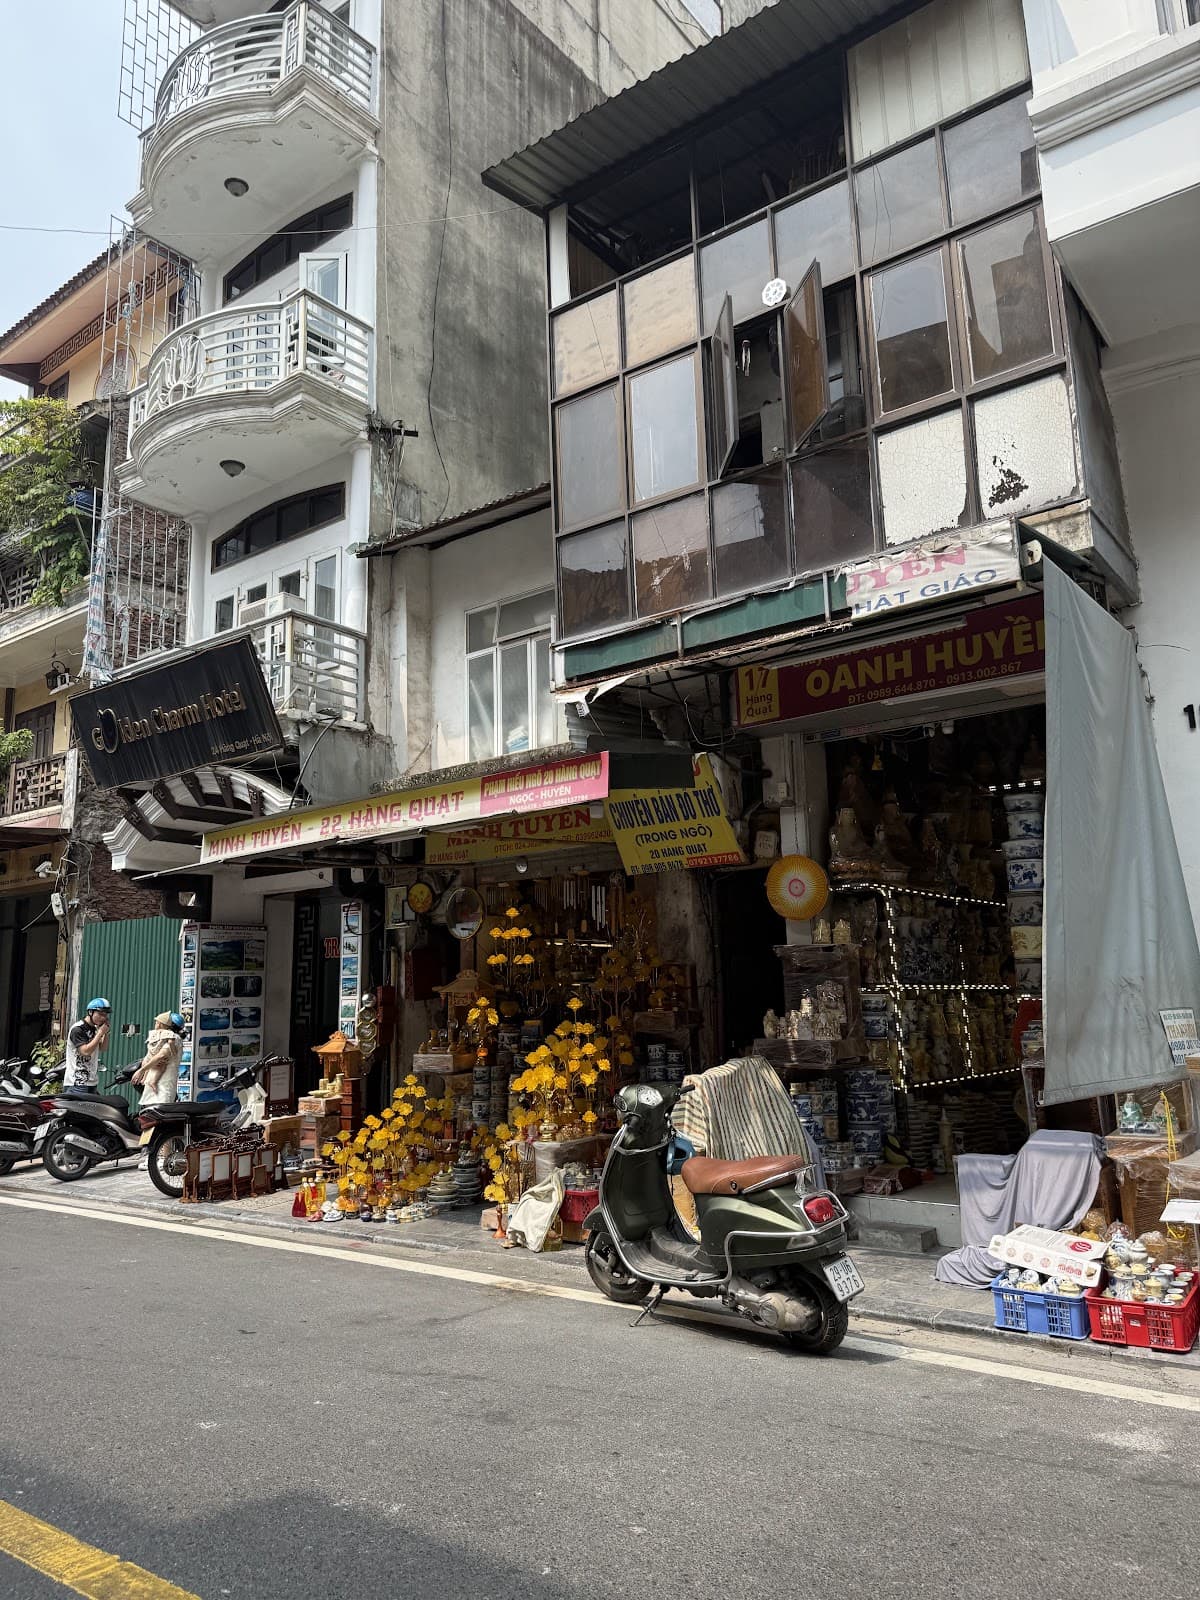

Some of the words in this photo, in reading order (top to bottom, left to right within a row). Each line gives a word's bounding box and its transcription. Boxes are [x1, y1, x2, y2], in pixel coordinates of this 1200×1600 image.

[920, 569, 997, 597] GIÁO
[745, 667, 769, 690] 17
[805, 649, 912, 698] OANH
[867, 677, 936, 701] 0989.644.870
[947, 661, 1022, 685] 0913.002.867
[151, 703, 201, 734] Charm
[200, 682, 247, 721] Hotel
[510, 793, 534, 806] NGỌC
[209, 835, 246, 857] MINH
[320, 814, 342, 836] 22
[349, 803, 401, 830] HÀNG
[408, 790, 465, 820] QUẠT
[635, 830, 677, 847] (TRONG
[837, 1275, 860, 1297] 9376
